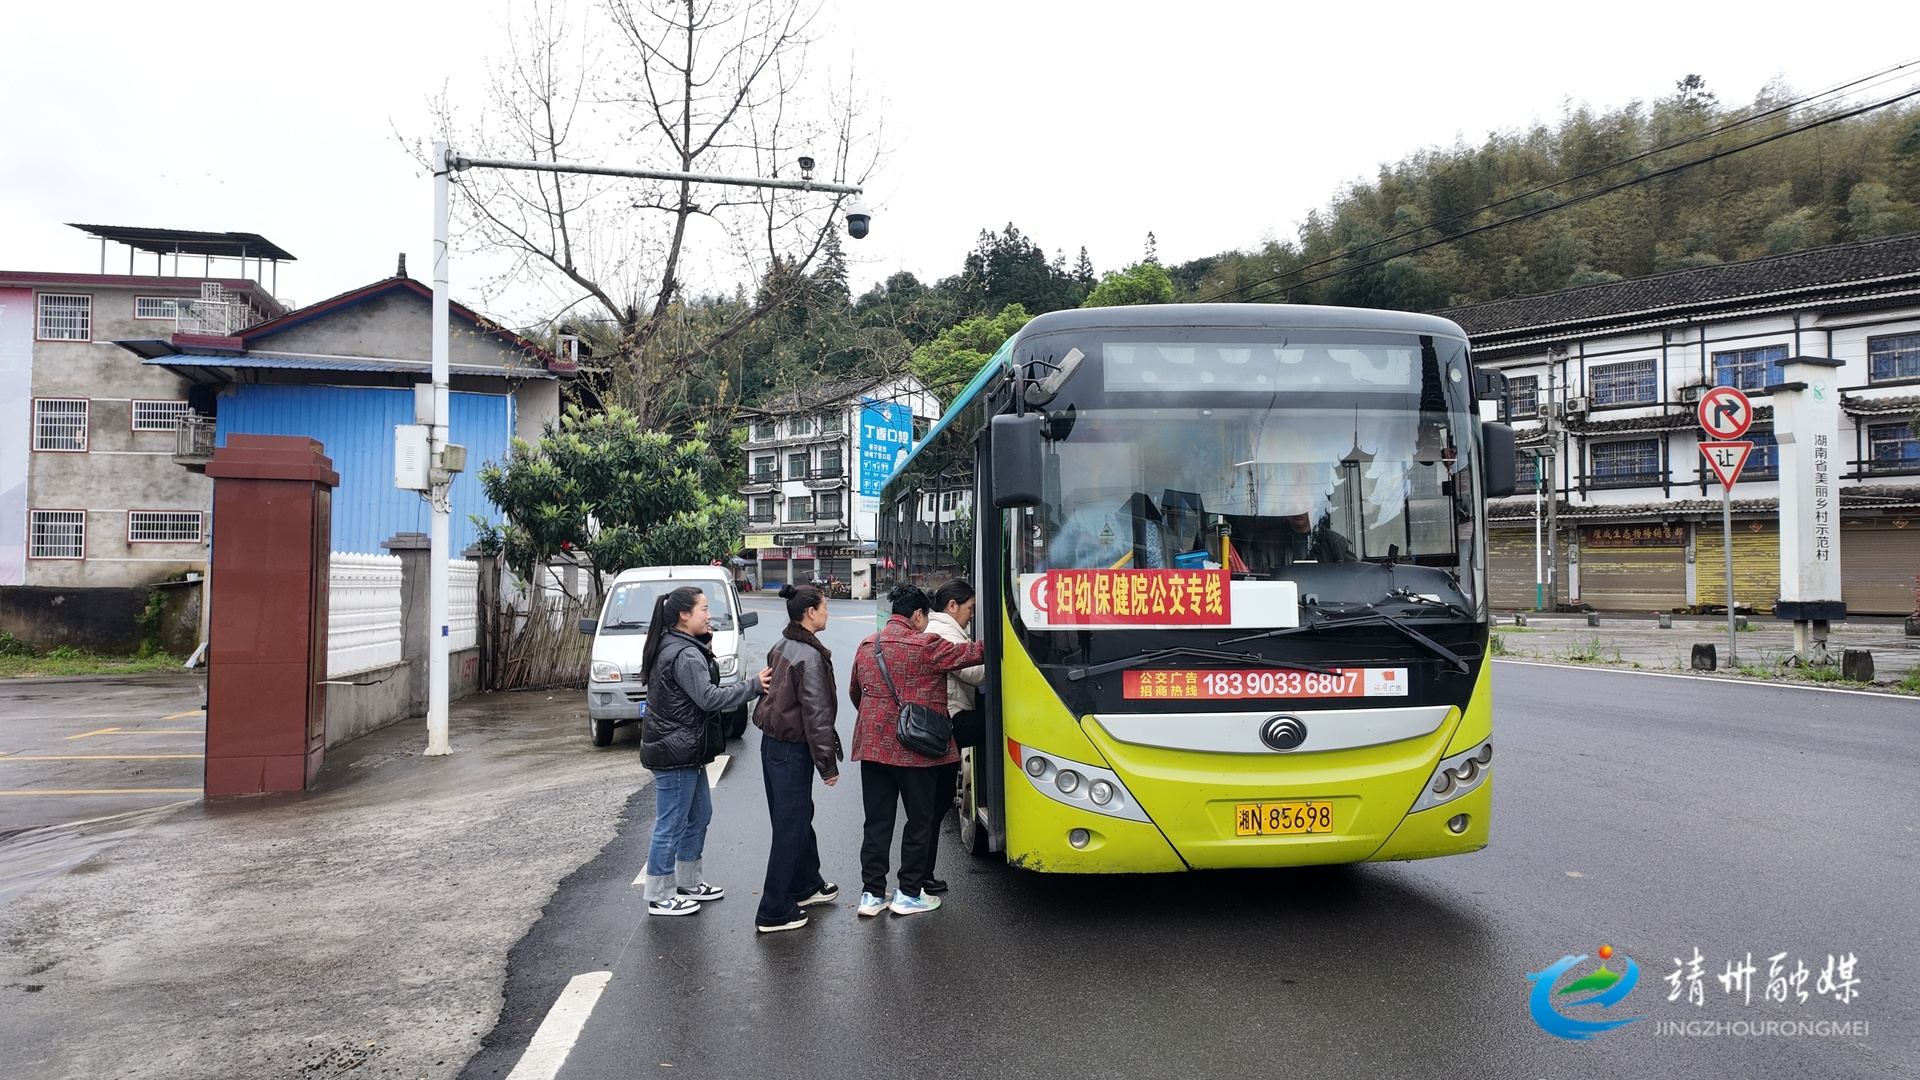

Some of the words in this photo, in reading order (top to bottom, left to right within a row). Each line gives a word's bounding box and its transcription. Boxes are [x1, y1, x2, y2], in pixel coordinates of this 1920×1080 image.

[1715, 448, 1736, 469] 让
[1814, 433, 1830, 562] 湖南省美丽乡村示范村
[1056, 572, 1223, 616] 妇幼保健院公交专线
[1140, 672, 1198, 684] 公交广告
[1140, 684, 1198, 697] 招商热线
